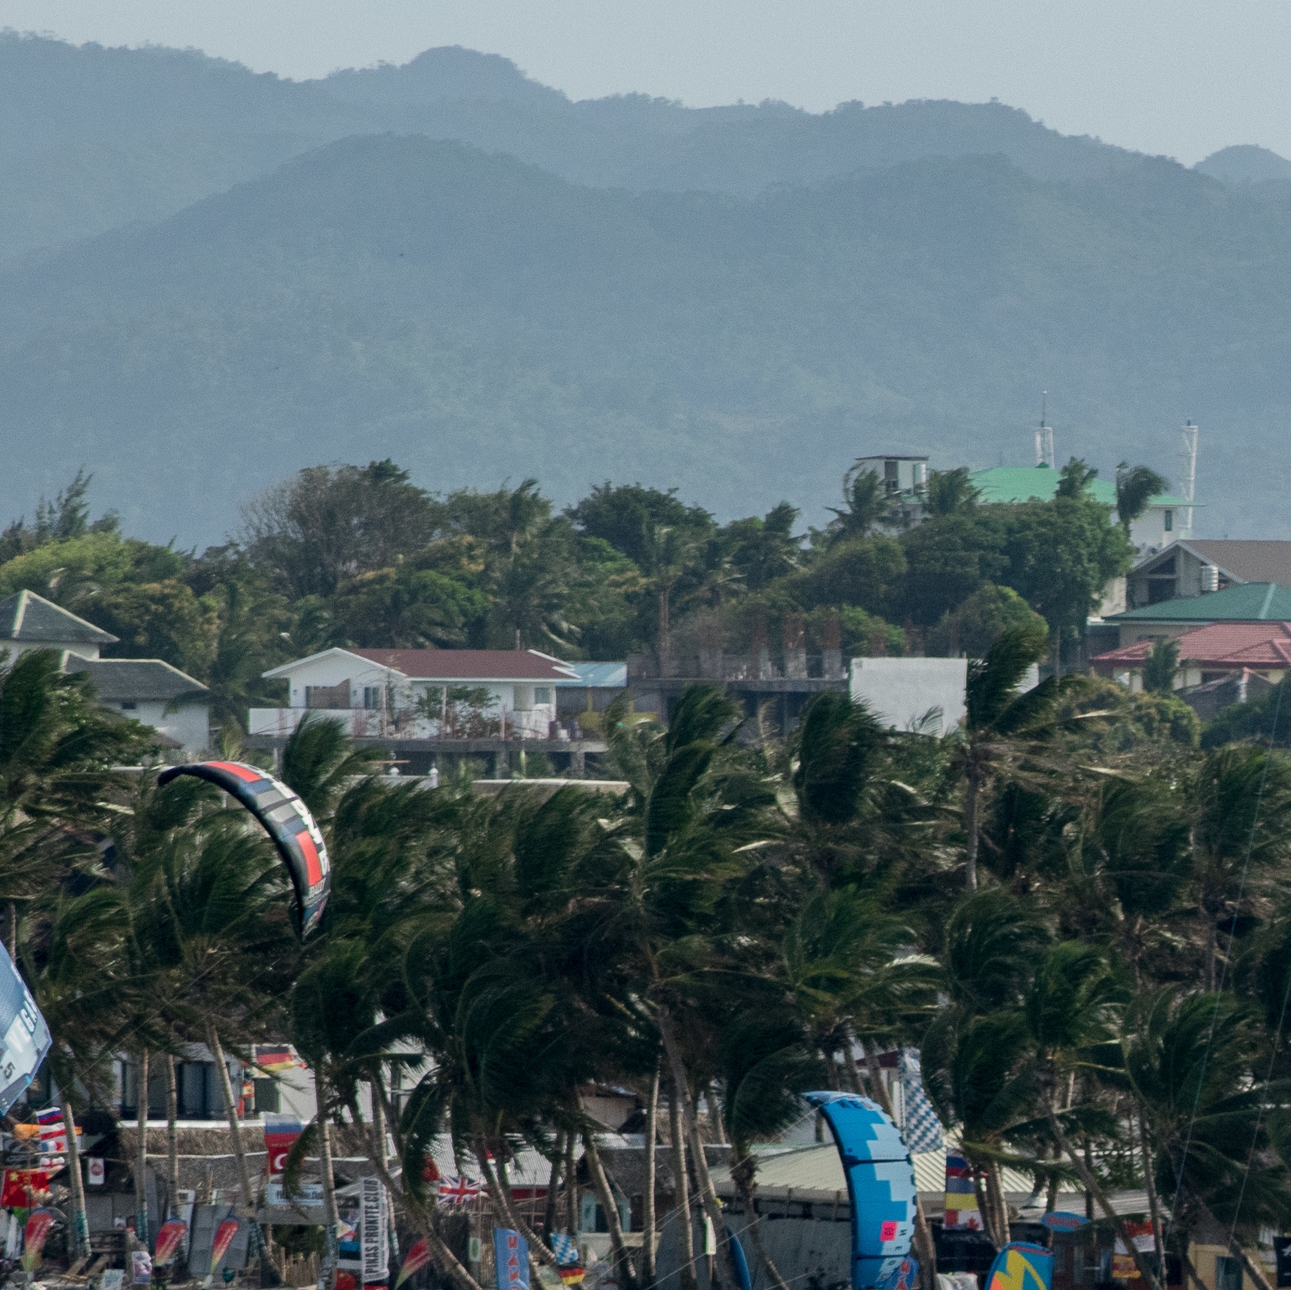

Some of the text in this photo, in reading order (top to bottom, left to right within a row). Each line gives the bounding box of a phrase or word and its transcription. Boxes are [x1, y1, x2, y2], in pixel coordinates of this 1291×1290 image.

[364, 1179, 379, 1203] CLUB
[364, 1205, 379, 1244] PROKITE
[364, 1246, 379, 1275] PINAS
